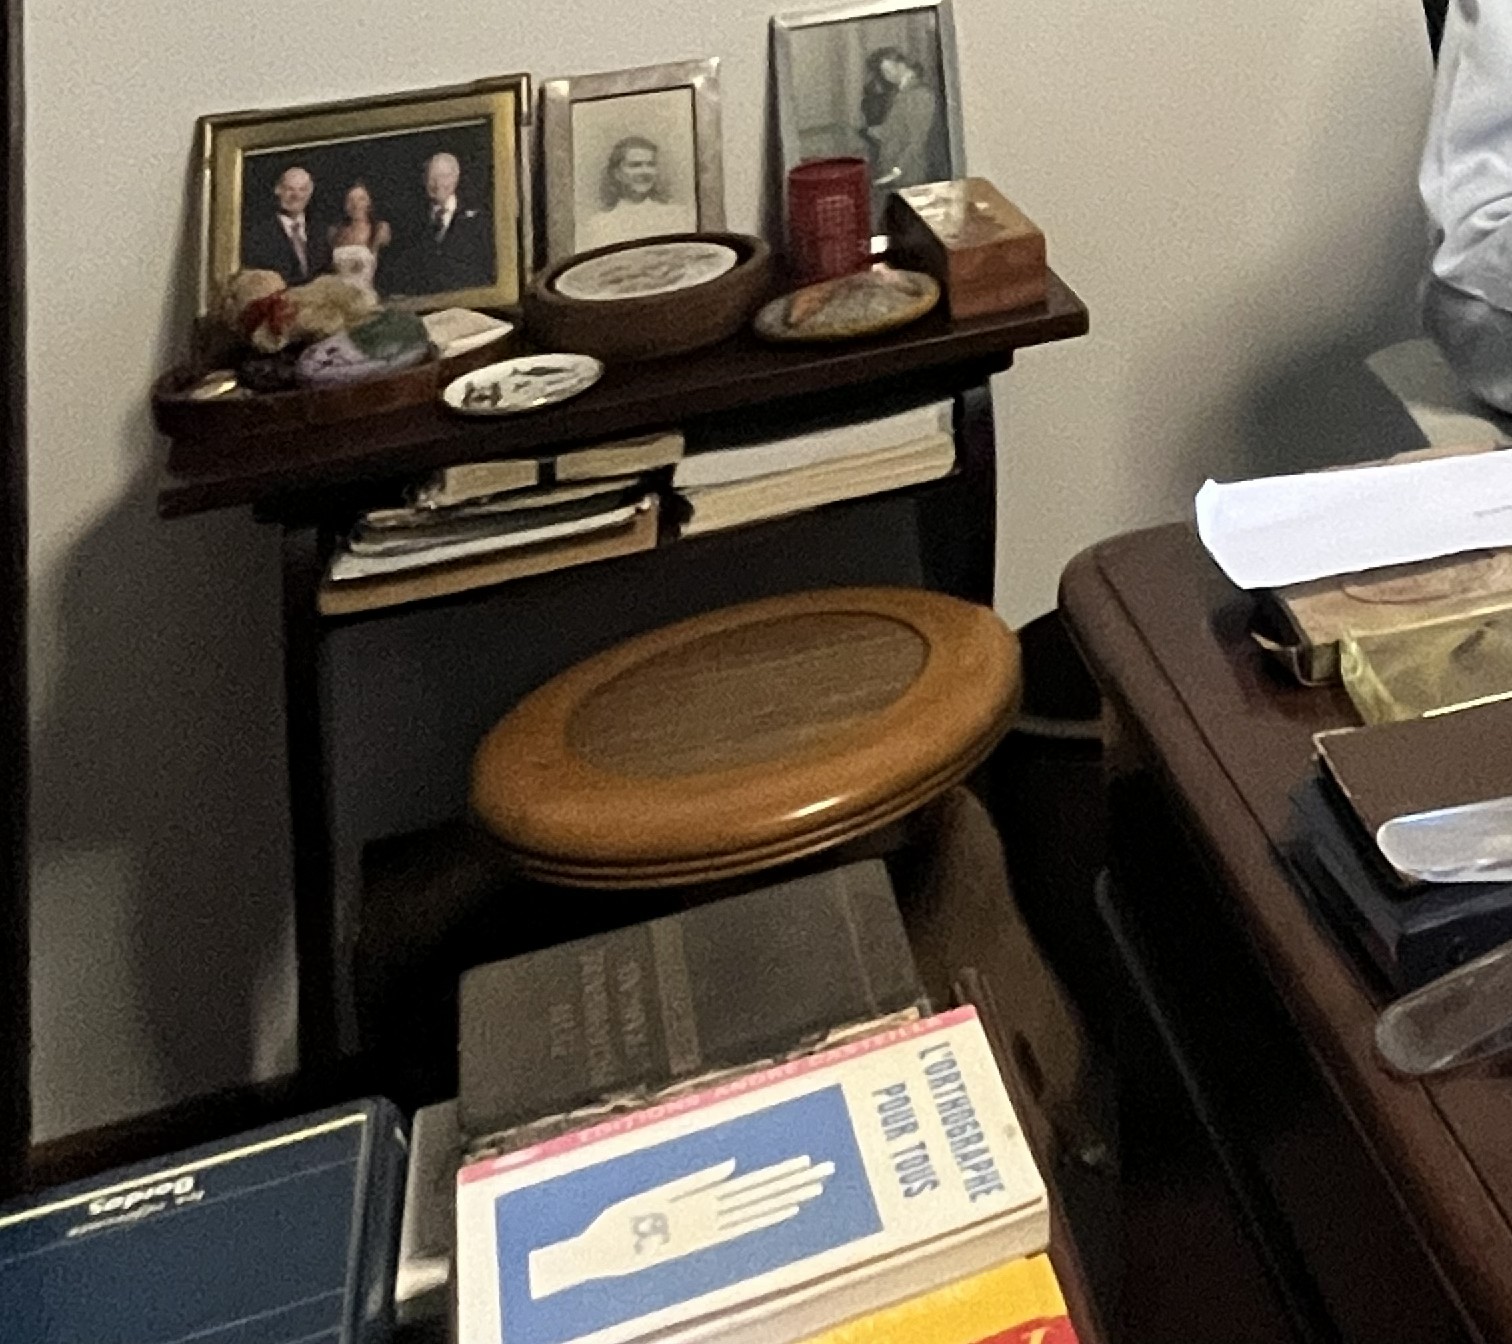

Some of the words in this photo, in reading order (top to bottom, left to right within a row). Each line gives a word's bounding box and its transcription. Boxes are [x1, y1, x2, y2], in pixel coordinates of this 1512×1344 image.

[871, 1081, 919, 1142] POUR
[918, 1041, 1006, 1203] L'ORTHOGRAPHE
[890, 1140, 940, 1198] TOUS
